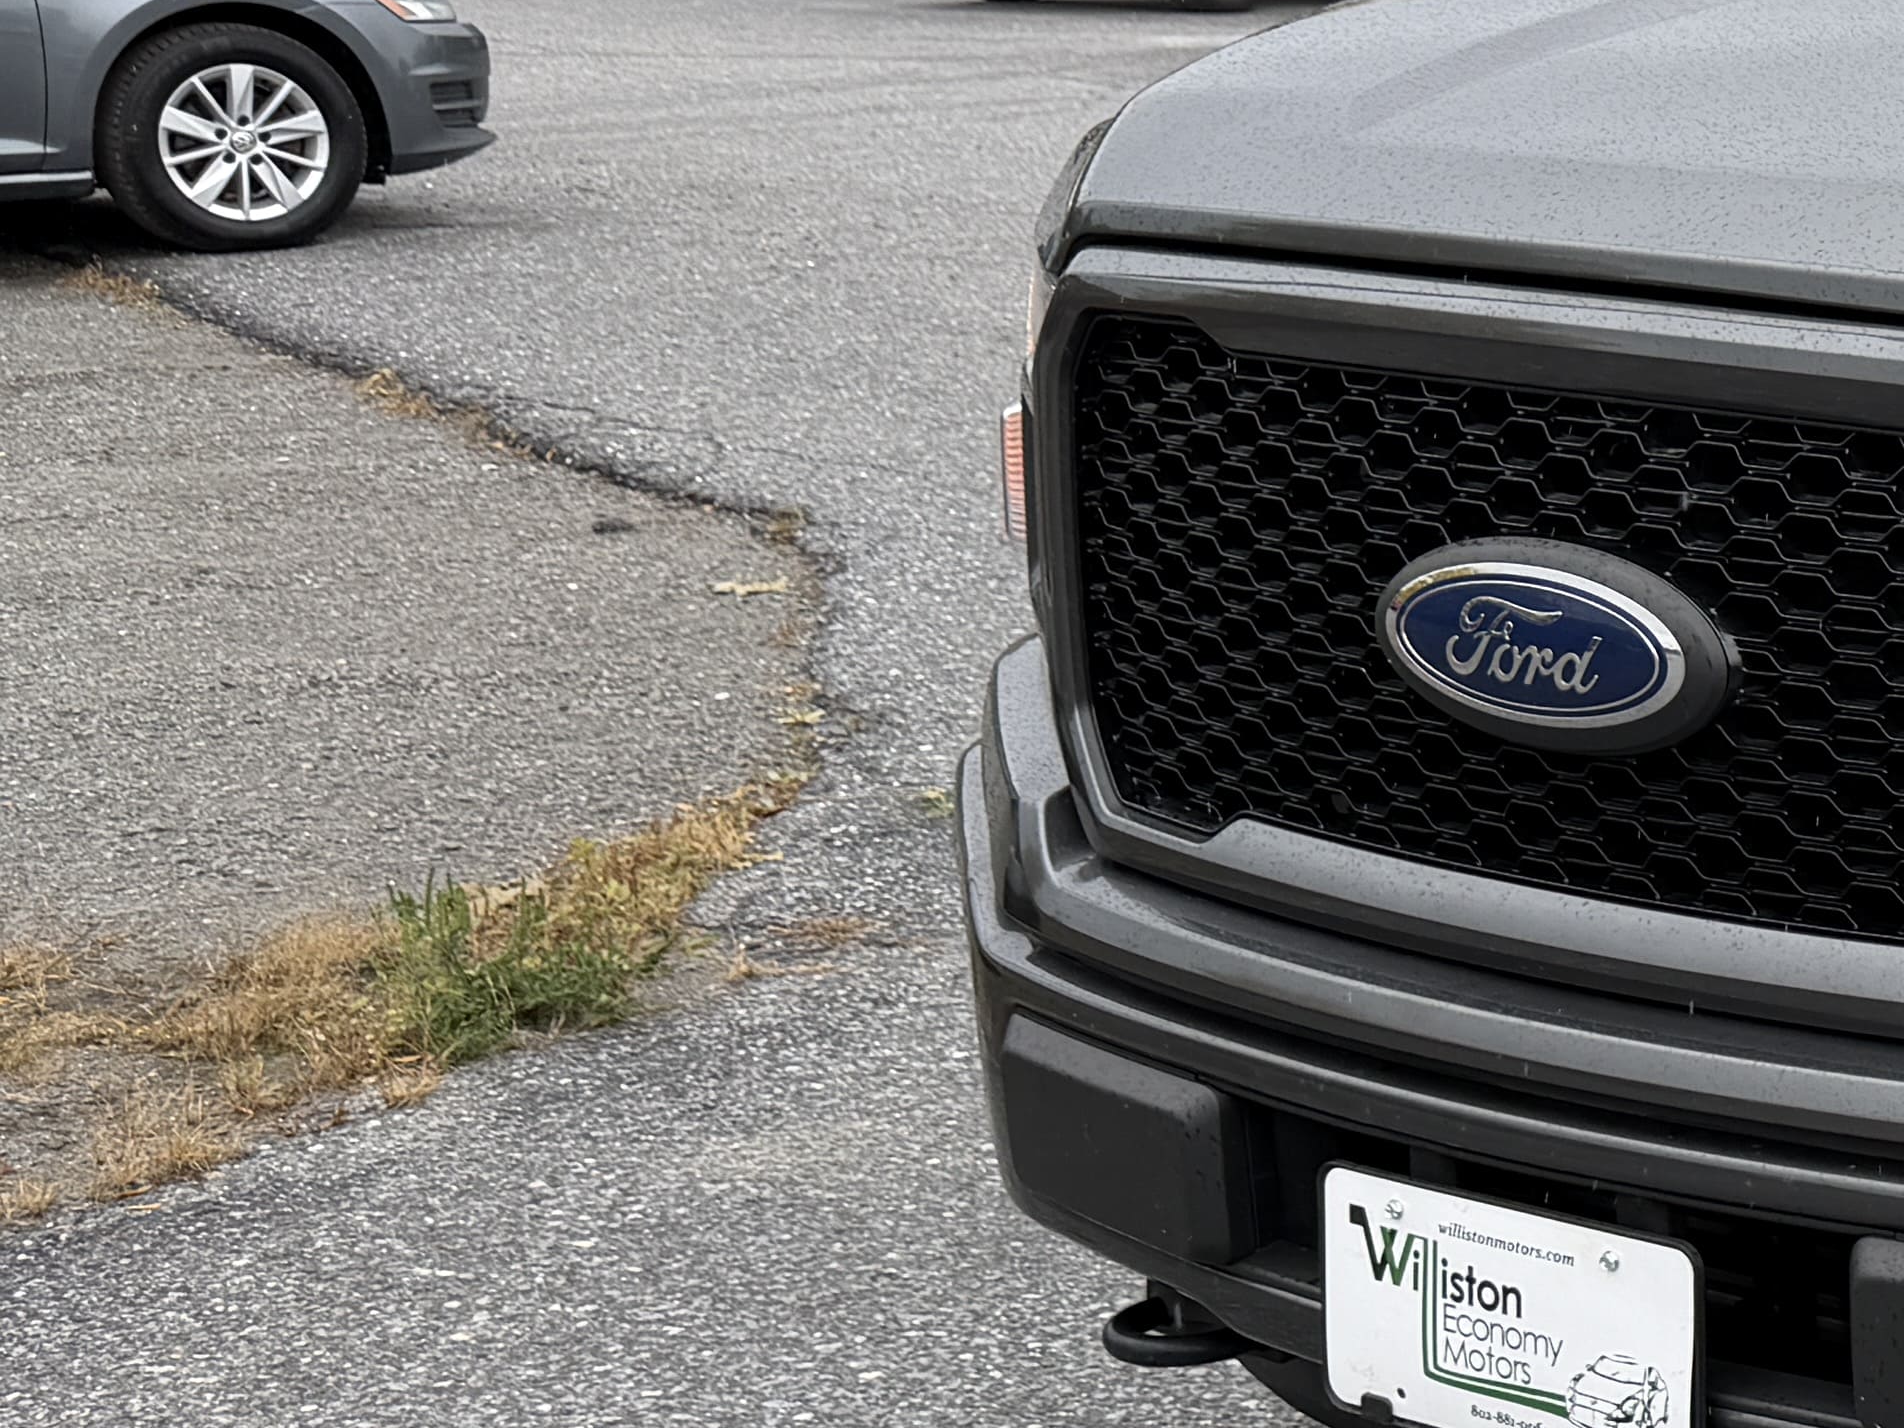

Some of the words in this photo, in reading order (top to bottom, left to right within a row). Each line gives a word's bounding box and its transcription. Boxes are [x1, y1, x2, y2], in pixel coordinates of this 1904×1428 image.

[1444, 594, 1603, 696] Ford
[1349, 1203, 1523, 1319] Williston
[1437, 1222, 1575, 1267] willistonmotors.com
[1442, 1302, 1564, 1368] Economy
[1443, 1336, 1533, 1385] Motors
